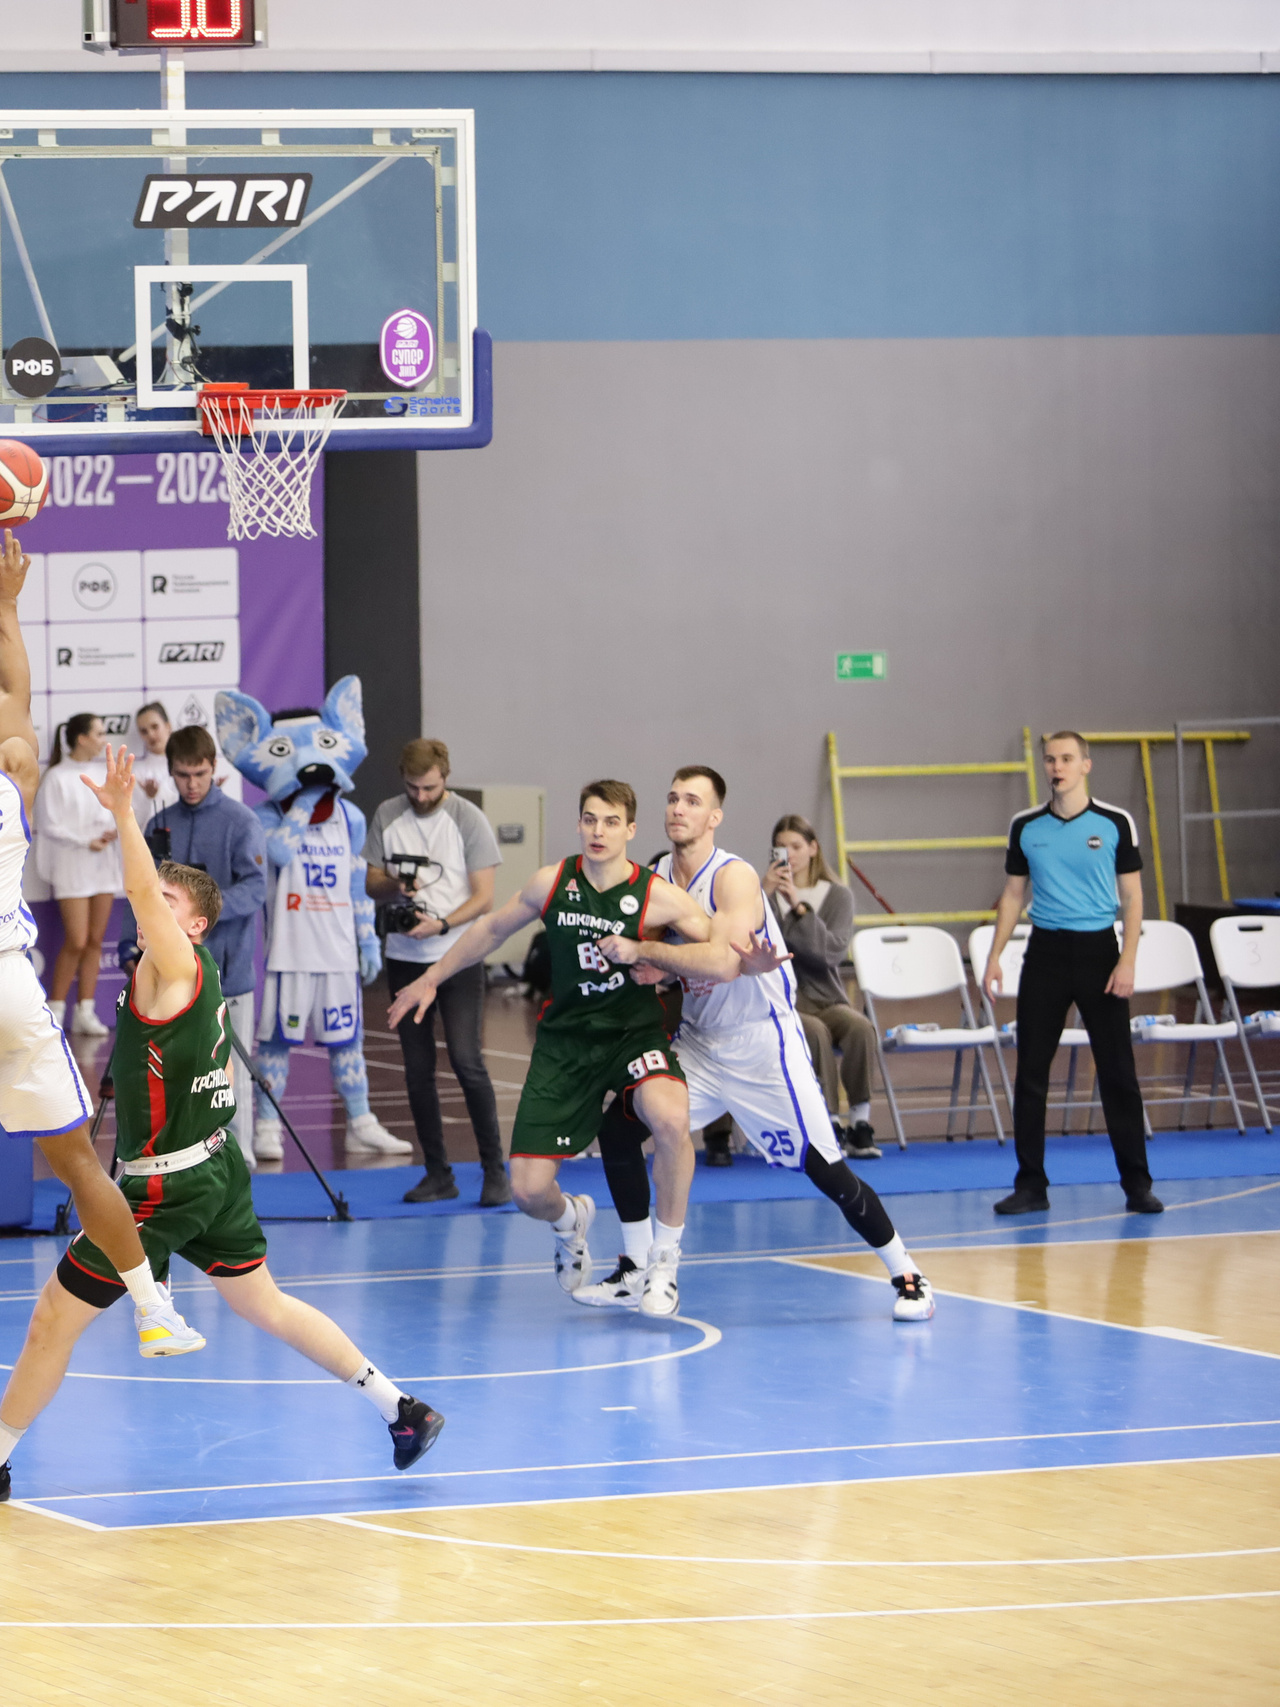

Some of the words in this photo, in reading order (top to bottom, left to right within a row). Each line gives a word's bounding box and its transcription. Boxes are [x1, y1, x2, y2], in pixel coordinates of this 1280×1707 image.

[140, 178, 307, 223] PARI
[12, 359, 54, 376] РФБ
[409, 405, 461, 416] Sports
[302, 863, 338, 888] 125
[323, 1004, 354, 1032] 125
[760, 1130, 795, 1157] 25
